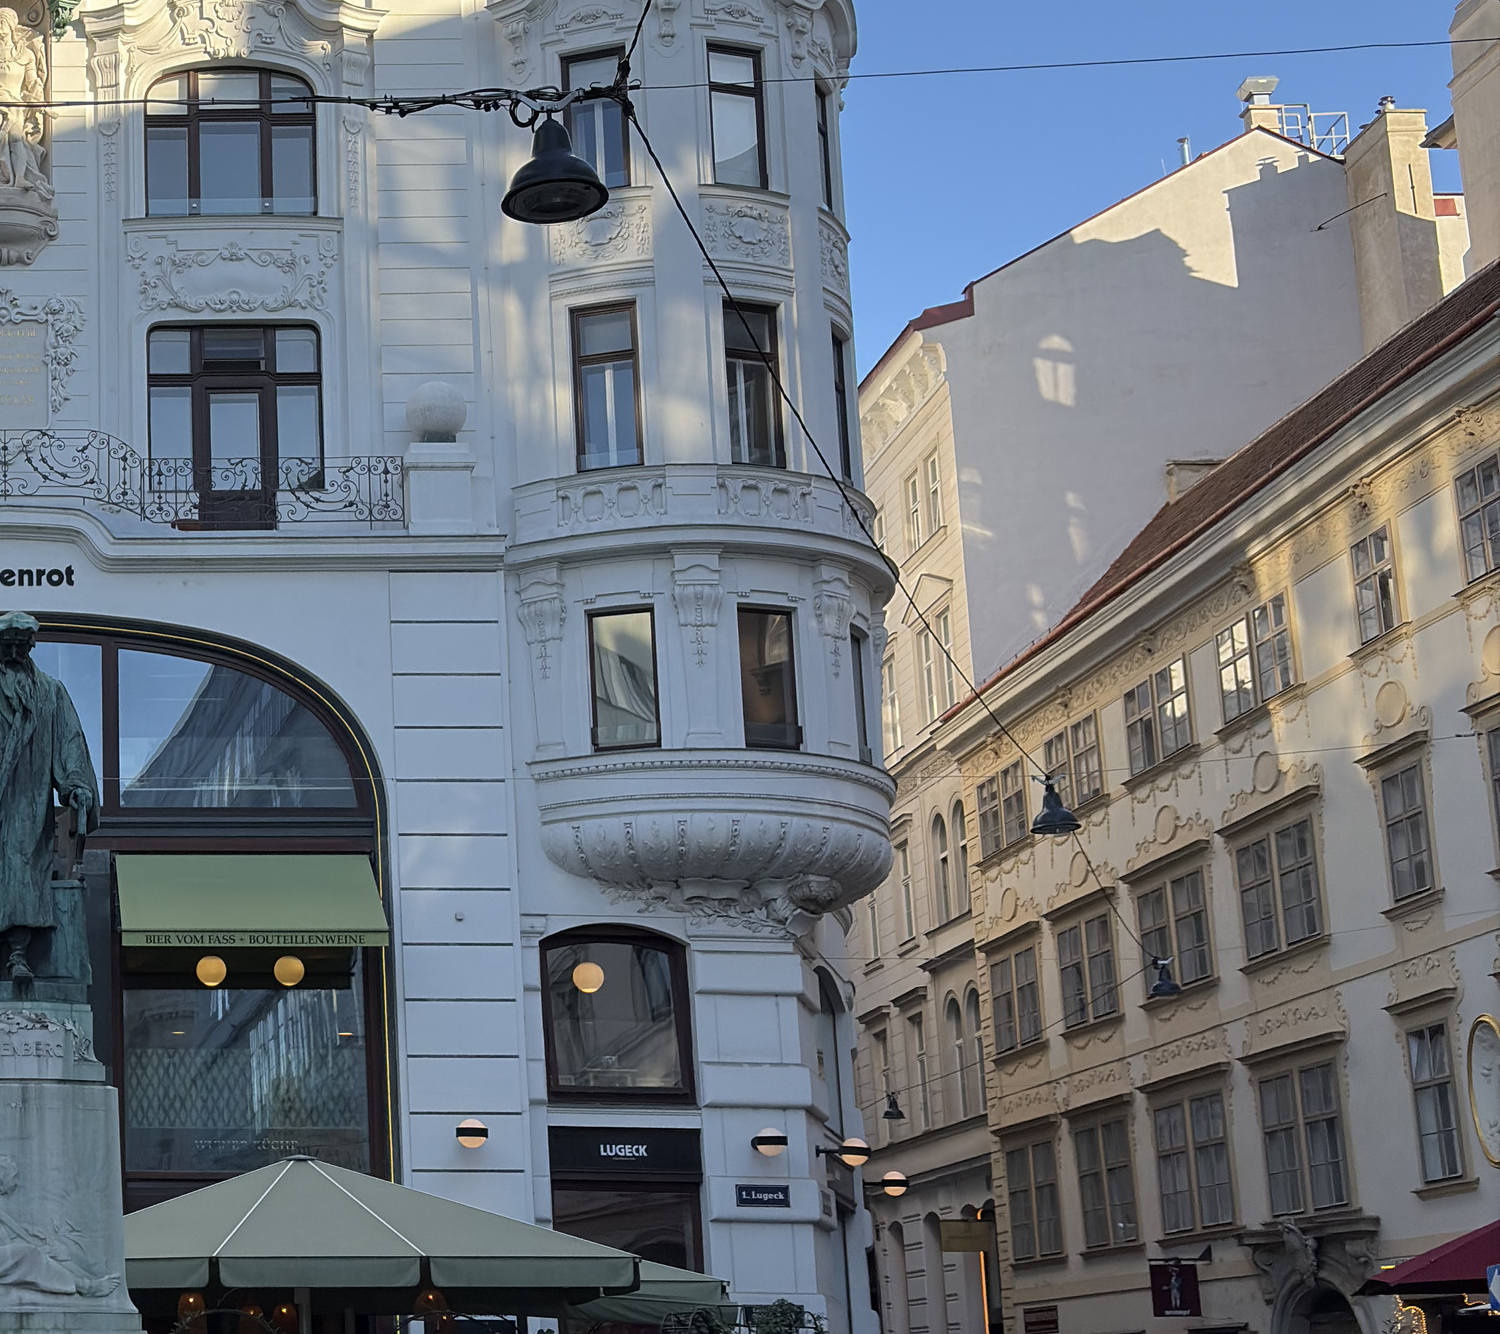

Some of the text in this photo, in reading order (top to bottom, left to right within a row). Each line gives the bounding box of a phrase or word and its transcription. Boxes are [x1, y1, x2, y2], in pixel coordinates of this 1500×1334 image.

[145, 934, 172, 945] BIER
[176, 934, 204, 945] VOM
[208, 934, 236, 945] FASS
[249, 934, 366, 945] BOUTEILLENWEINE
[600, 1144, 648, 1157] LUGECK
[751, 1191, 785, 1201] Lugeck
